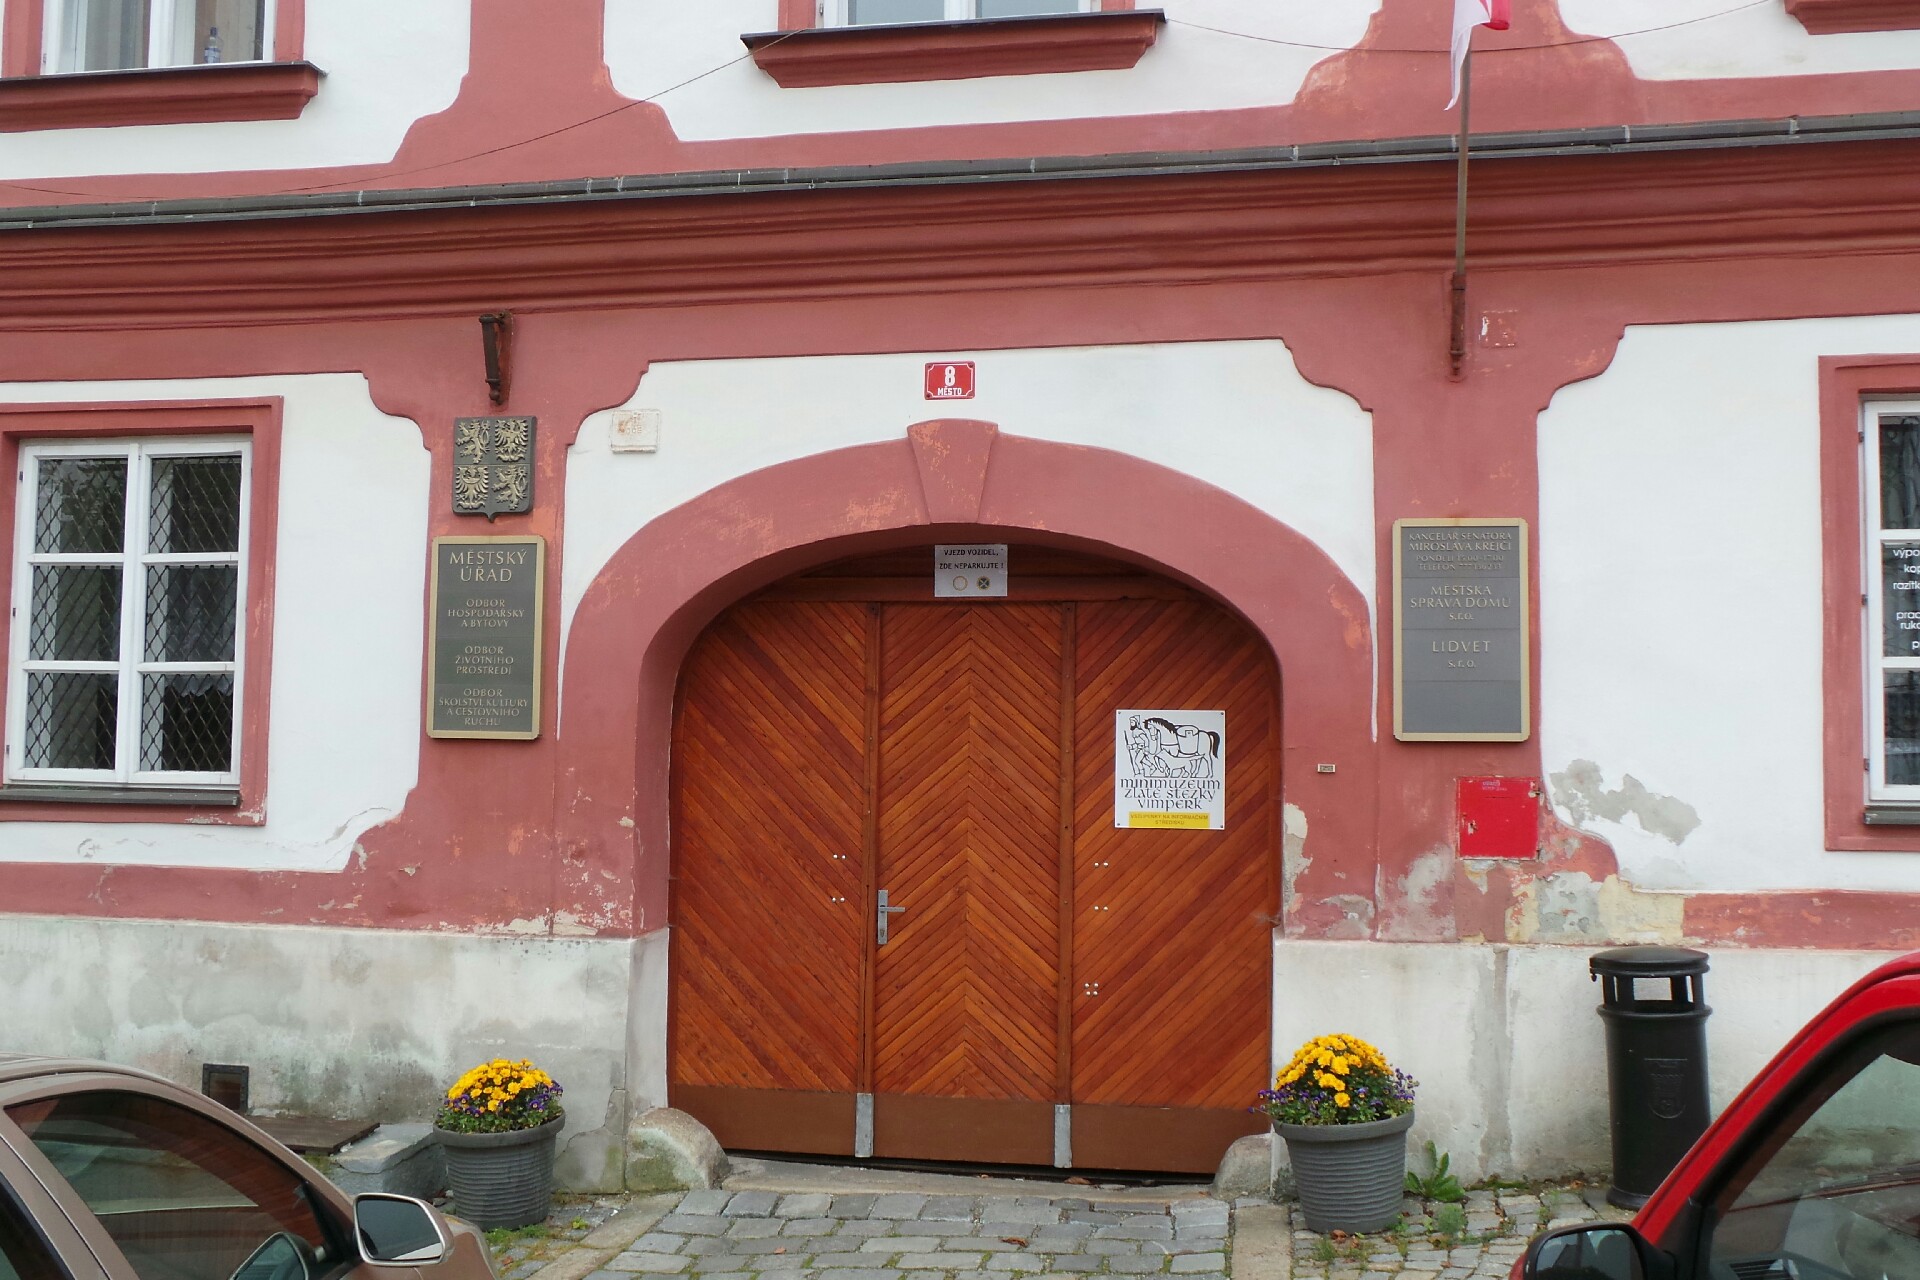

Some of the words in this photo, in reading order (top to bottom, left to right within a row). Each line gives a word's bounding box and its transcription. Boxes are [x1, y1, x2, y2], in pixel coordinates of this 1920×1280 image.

[945, 366, 955, 386] 8
[938, 386, 962, 396] MĚSTO
[1461, 532, 1512, 541] SENATORA
[1408, 542, 1473, 551] MIROSLAVA
[449, 548, 527, 565] MĚSTSKÝ
[1419, 563, 1456, 571] TELEFON
[460, 566, 512, 582] ÚŘAD
[466, 599, 505, 608] ODBOR
[461, 619, 468, 628] A
[464, 645, 504, 655] ODBOR
[1432, 640, 1491, 652] LIDVET
[455, 655, 514, 665] ŽIVOTNÍHO
[463, 688, 503, 697] ODBOR
[486, 699, 528, 708] KULTURY
[446, 708, 453, 716] A
[464, 717, 501, 726] RUCHU
